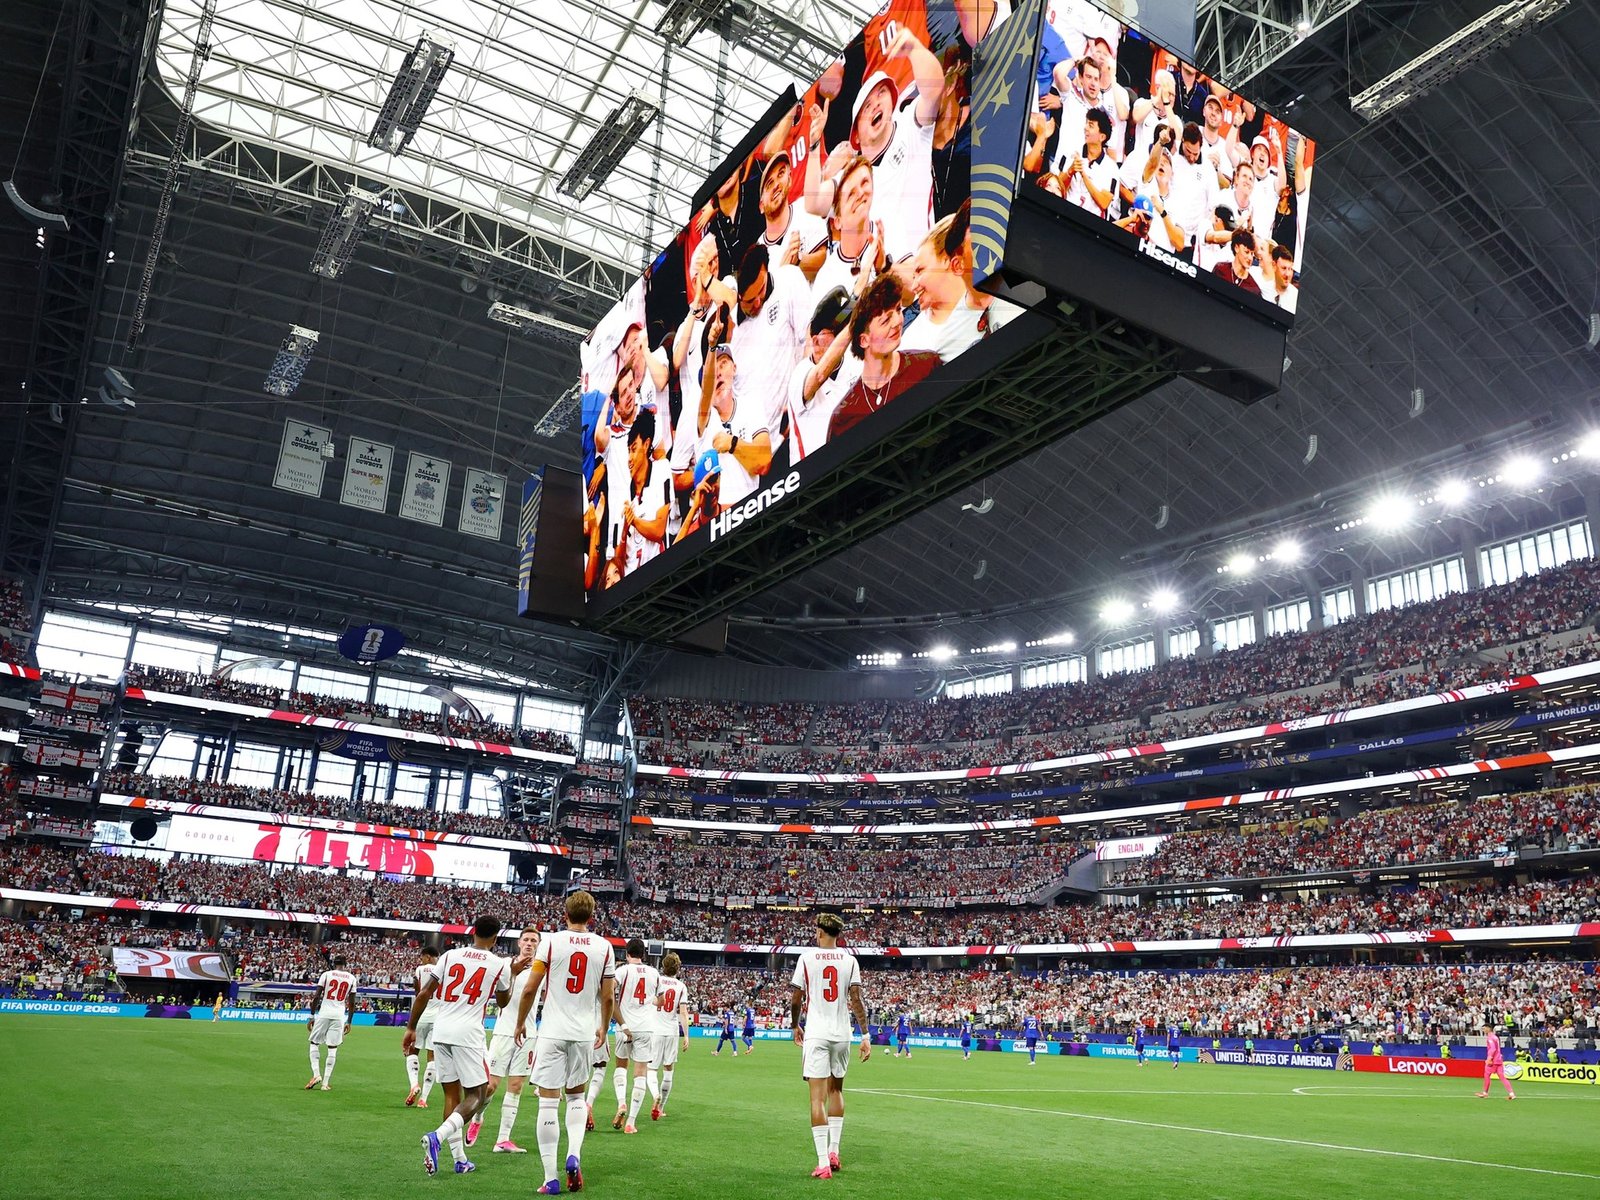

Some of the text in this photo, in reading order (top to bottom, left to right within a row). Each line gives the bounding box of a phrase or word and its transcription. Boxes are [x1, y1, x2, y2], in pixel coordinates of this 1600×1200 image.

[791, 135, 806, 169] 10
[1138, 237, 1198, 278] Hisense
[291, 441, 320, 453] COWBOYS
[294, 436, 318, 447] DALLAS
[355, 458, 383, 469] COWBOYS
[359, 453, 382, 463] DALLAS
[287, 468, 313, 479] WORLD
[414, 472, 441, 484] COWBOYS
[417, 468, 439, 478] DALLAS
[278, 472, 319, 487] CHAMPIONS
[353, 485, 377, 496] WORLD
[345, 490, 383, 503] CHAMPIONS
[412, 499, 435, 510] WORLD
[710, 470, 801, 543] Hisense
[404, 504, 440, 517] CHAMPIONS
[470, 513, 493, 523] WORLD
[463, 518, 498, 531] CHAMPIONS
[1537, 711, 1555, 721] FIFA
[1555, 706, 1588, 718] WORLD
[346, 743, 370, 752] WORLD
[359, 739, 373, 747] FIFA
[1358, 737, 1404, 751] DALLAS
[351, 750, 375, 758] 2026
[1011, 788, 1043, 799] DALLAS
[733, 796, 768, 804] DALLAS
[336, 821, 345, 829] 2
[1118, 843, 1144, 854] ENGLAN
[569, 936, 591, 946] KANE
[462, 950, 488, 961] JAMES
[815, 952, 844, 961] O'REILLY
[565, 951, 589, 994] 9
[444, 962, 487, 1006] 24
[822, 965, 839, 1003] 3
[326, 978, 350, 1002] 20
[633, 977, 647, 1005] 4
[656, 988, 676, 1013] 8
[0, 1001, 23, 1010] FIFA
[25, 1003, 61, 1012] WORLD
[62, 1004, 83, 1012] CUP
[221, 1010, 241, 1019] PLAY
[241, 1010, 255, 1019] THE
[254, 1010, 270, 1020] FIFA
[270, 1011, 296, 1021] WORLD
[1028, 1020, 1037, 1030] 22
[702, 1029, 716, 1037] PLAY
[1140, 1030, 1145, 1038] 2
[1173, 1030, 1178, 1039] 6
[1102, 1047, 1116, 1055] FIFA
[1142, 1048, 1155, 1057] CUP
[527, 1050, 534, 1066] 8
[1215, 1051, 1244, 1062] UNITED
[1277, 1054, 1289, 1065] OF
[1290, 1055, 1334, 1068] AMERICA
[1388, 1057, 1447, 1075] Lenovo
[1527, 1065, 1597, 1080] mercado
